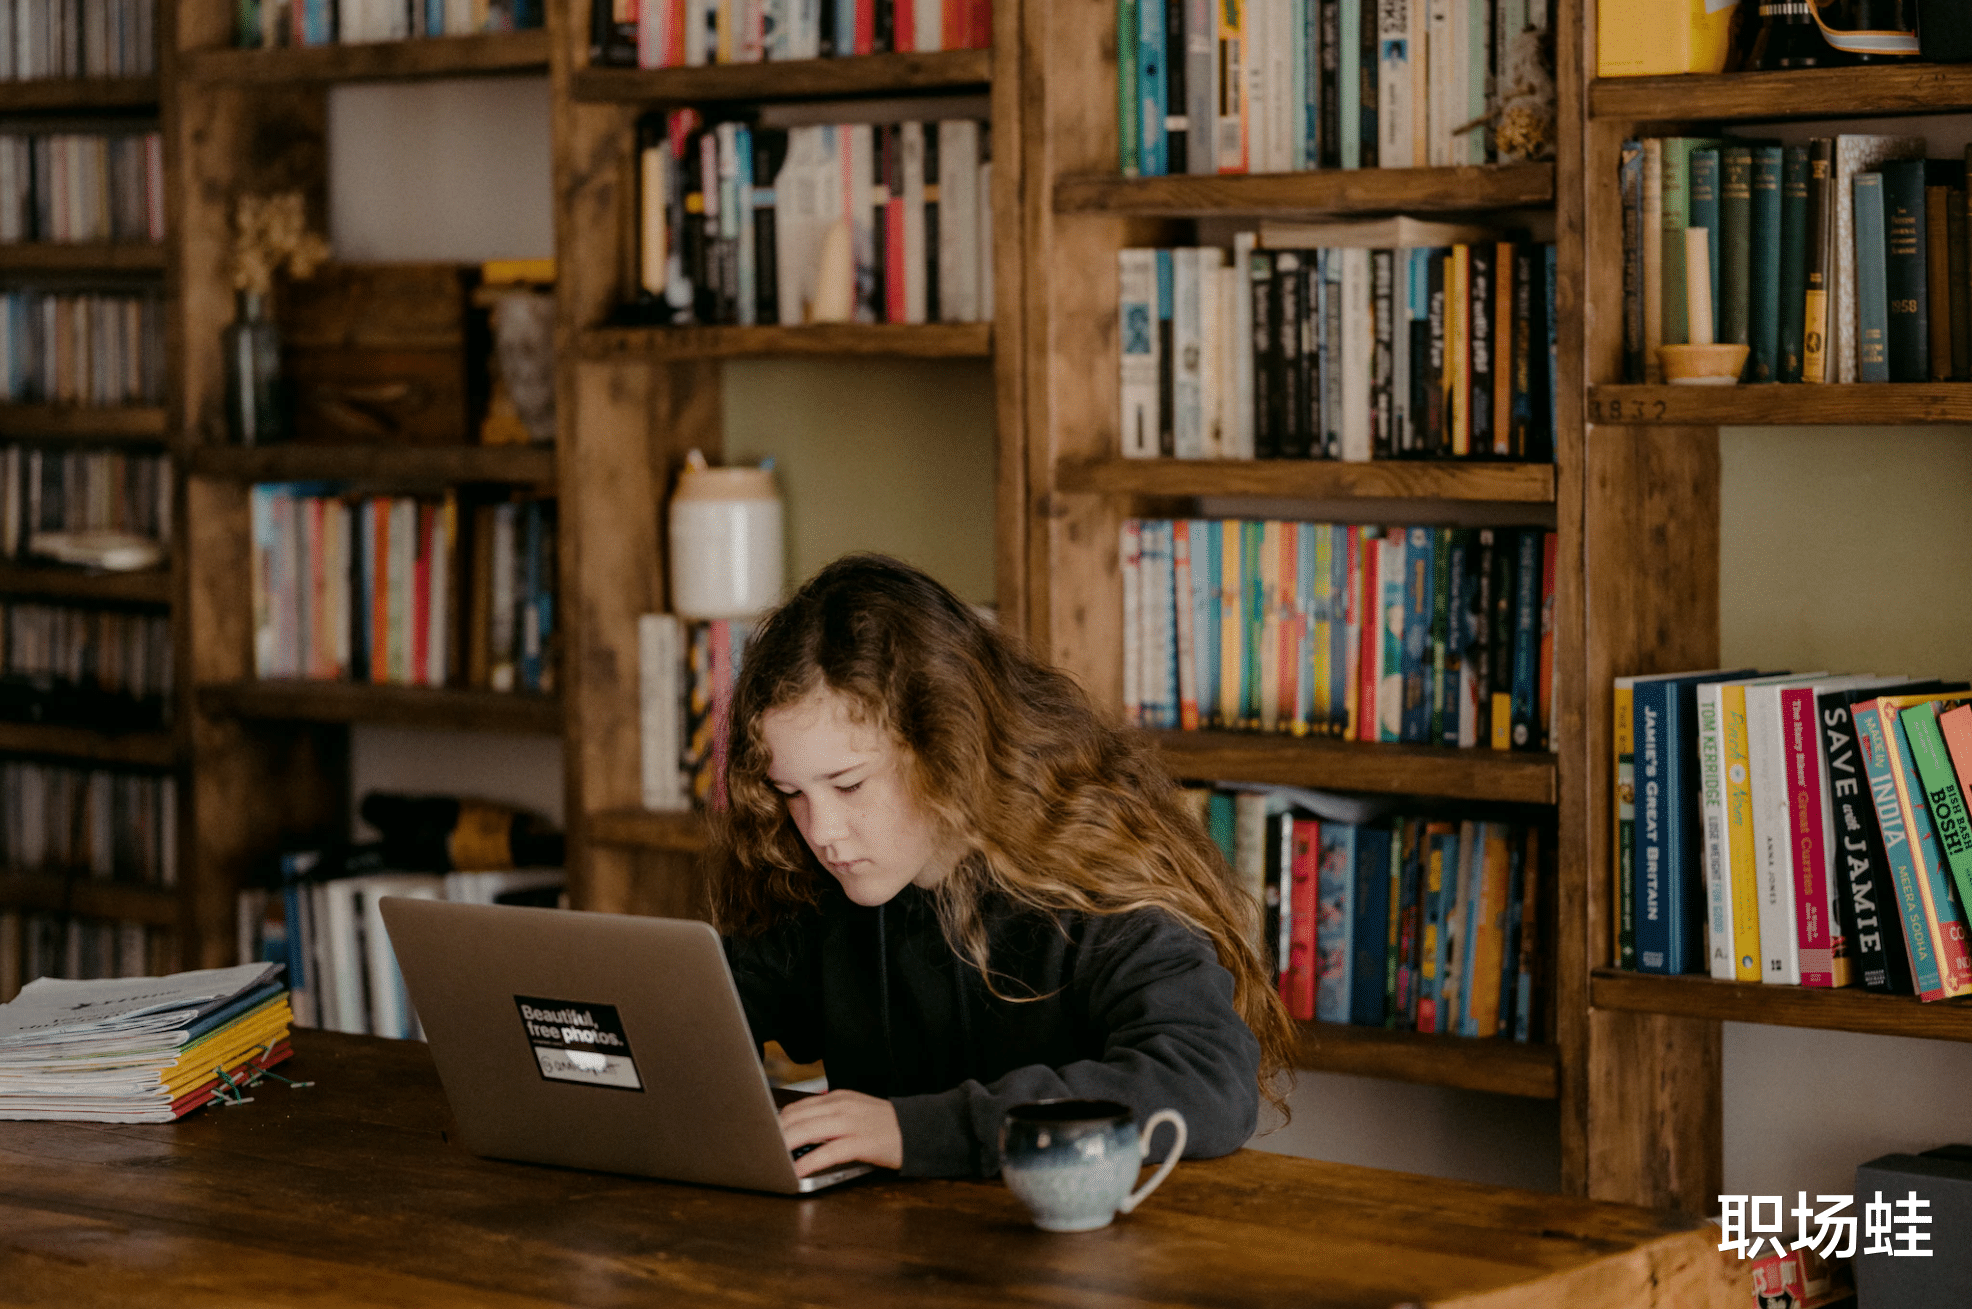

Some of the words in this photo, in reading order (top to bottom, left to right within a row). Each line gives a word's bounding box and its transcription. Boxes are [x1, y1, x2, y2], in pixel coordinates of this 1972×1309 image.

[1701, 702, 1716, 732] TOM
[1792, 699, 1802, 720] The
[1644, 705, 1658, 777] JAMIE'S
[1793, 722, 1803, 752] Hairy
[1703, 736, 1720, 808] KERRIDGE
[1645, 781, 1659, 842] GREAT
[1708, 816, 1719, 840] LOSE
[1798, 790, 1810, 834] Great
[1824, 707, 1858, 798] SAVE
[1844, 836, 1882, 953] JAMIE
[1871, 773, 1906, 849] INDIA
[1930, 788, 1964, 855] BOSH!
[1946, 784, 1962, 815] BISH
[1957, 816, 1972, 850] BASH
[1646, 846, 1659, 920] BRITAIN
[1710, 844, 1721, 881] WEIGHT
[1768, 871, 1776, 905] JONES
[1801, 837, 1813, 895] Curries
[1713, 905, 1724, 934] GOOD
[1898, 864, 1917, 912] MEERA
[1910, 913, 1928, 961] SODHA
[521, 1004, 599, 1030] Beautiful,
[527, 1020, 561, 1039] free
[561, 1026, 624, 1047] photos.
